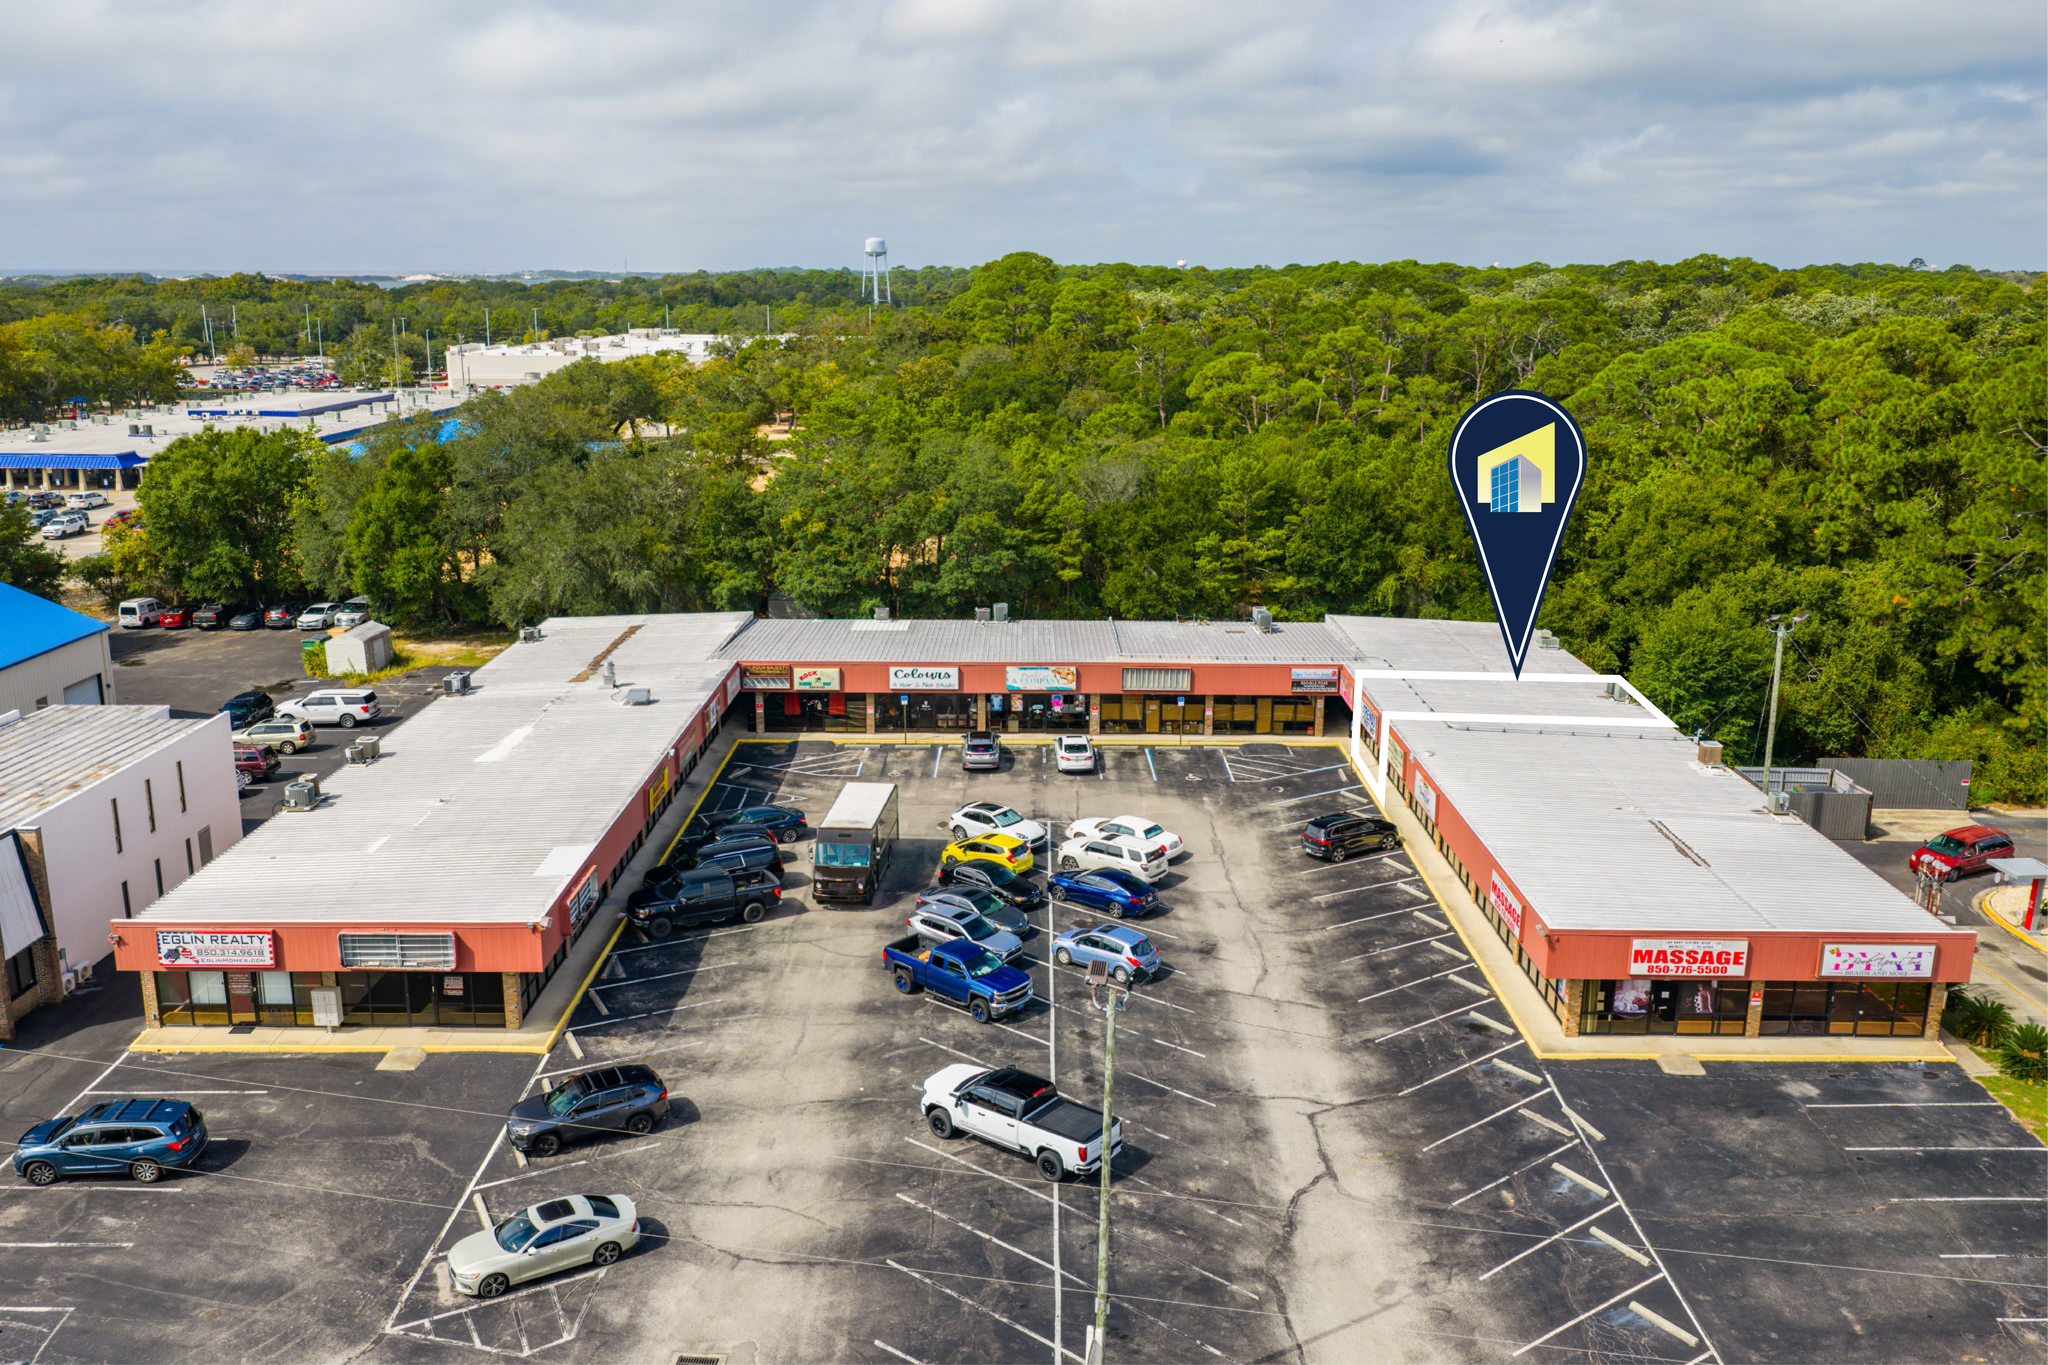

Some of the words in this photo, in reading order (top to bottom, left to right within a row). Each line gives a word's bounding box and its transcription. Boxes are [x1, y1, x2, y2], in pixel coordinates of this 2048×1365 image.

[799, 671, 817, 681] ROCK
[894, 668, 952, 679] Colours
[162, 935, 205, 945] EGLIN
[210, 935, 265, 945] REALTY
[1633, 950, 1745, 965] MASSAGE
[1647, 965, 1728, 974] 850-776-5500
